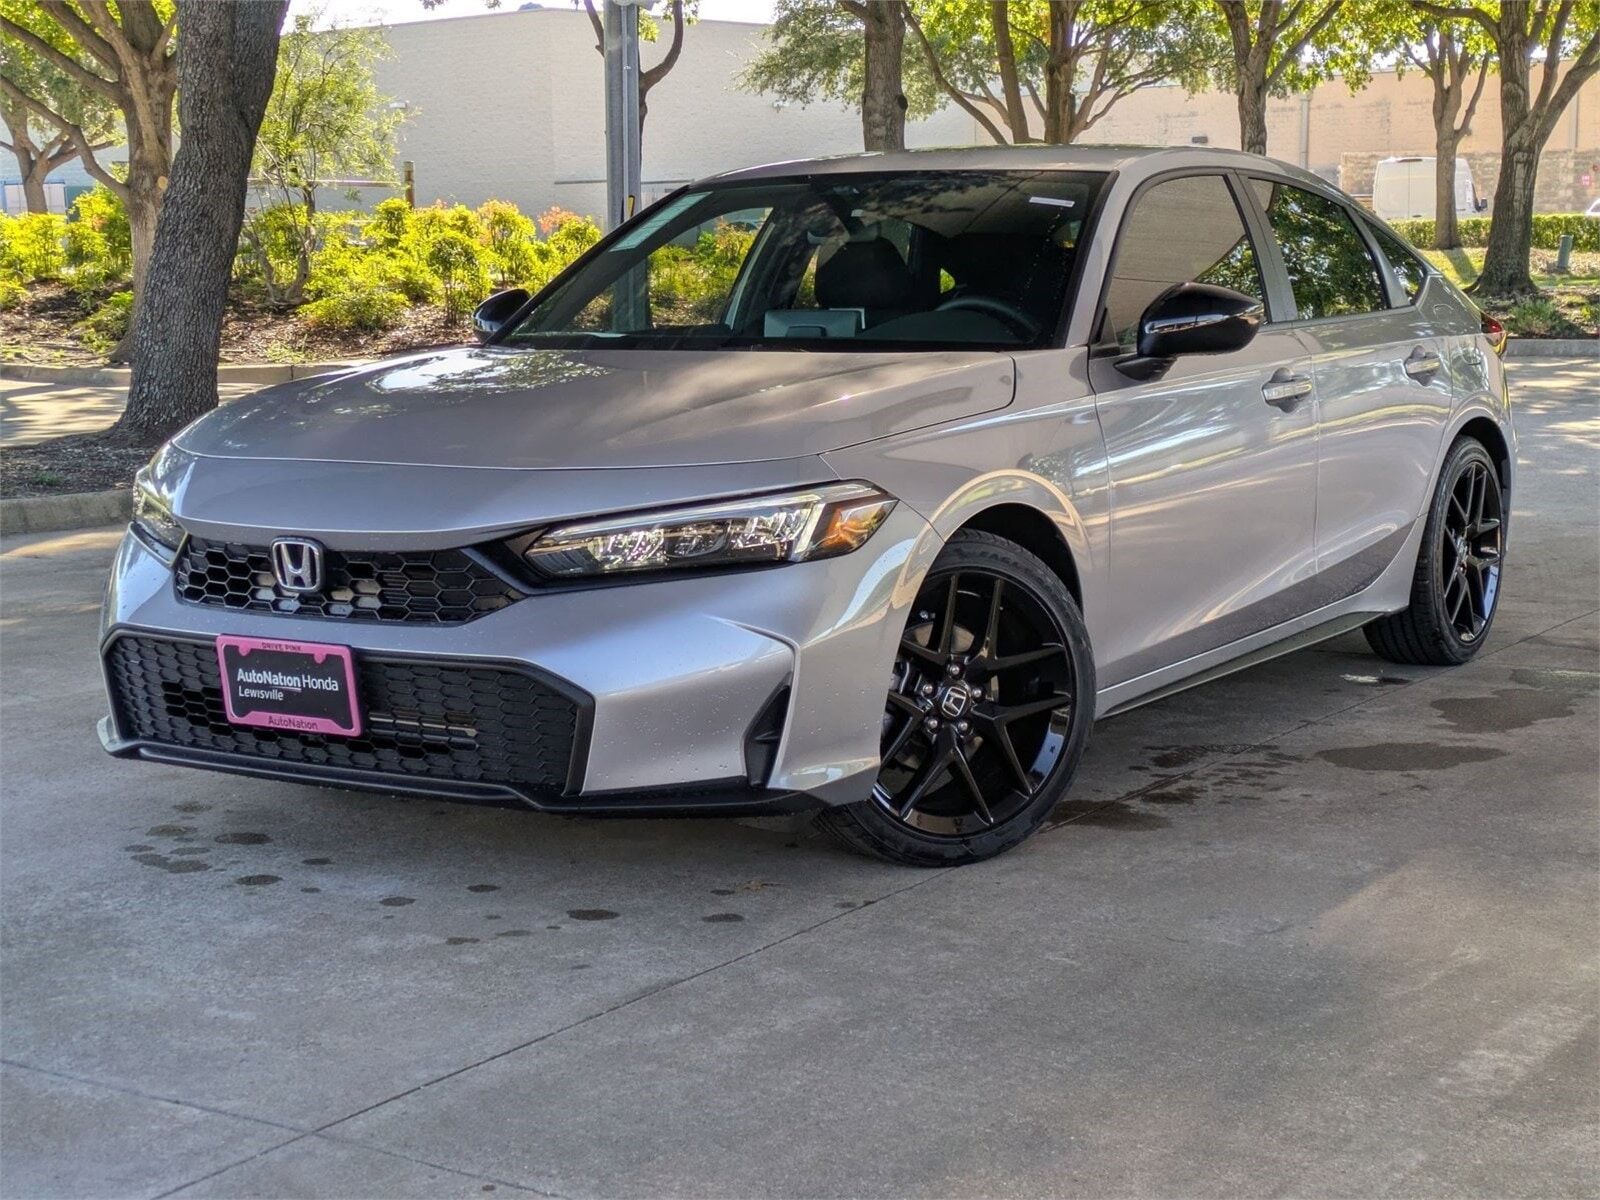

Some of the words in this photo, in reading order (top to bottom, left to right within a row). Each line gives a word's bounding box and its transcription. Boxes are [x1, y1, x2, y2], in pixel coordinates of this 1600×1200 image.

[261, 641, 282, 650] DRIVE
[284, 643, 301, 652] PINK
[236, 667, 301, 688] AutoNation
[302, 674, 339, 691] Honda
[238, 685, 284, 701] Lewisville
[268, 715, 318, 731] AutoNation
